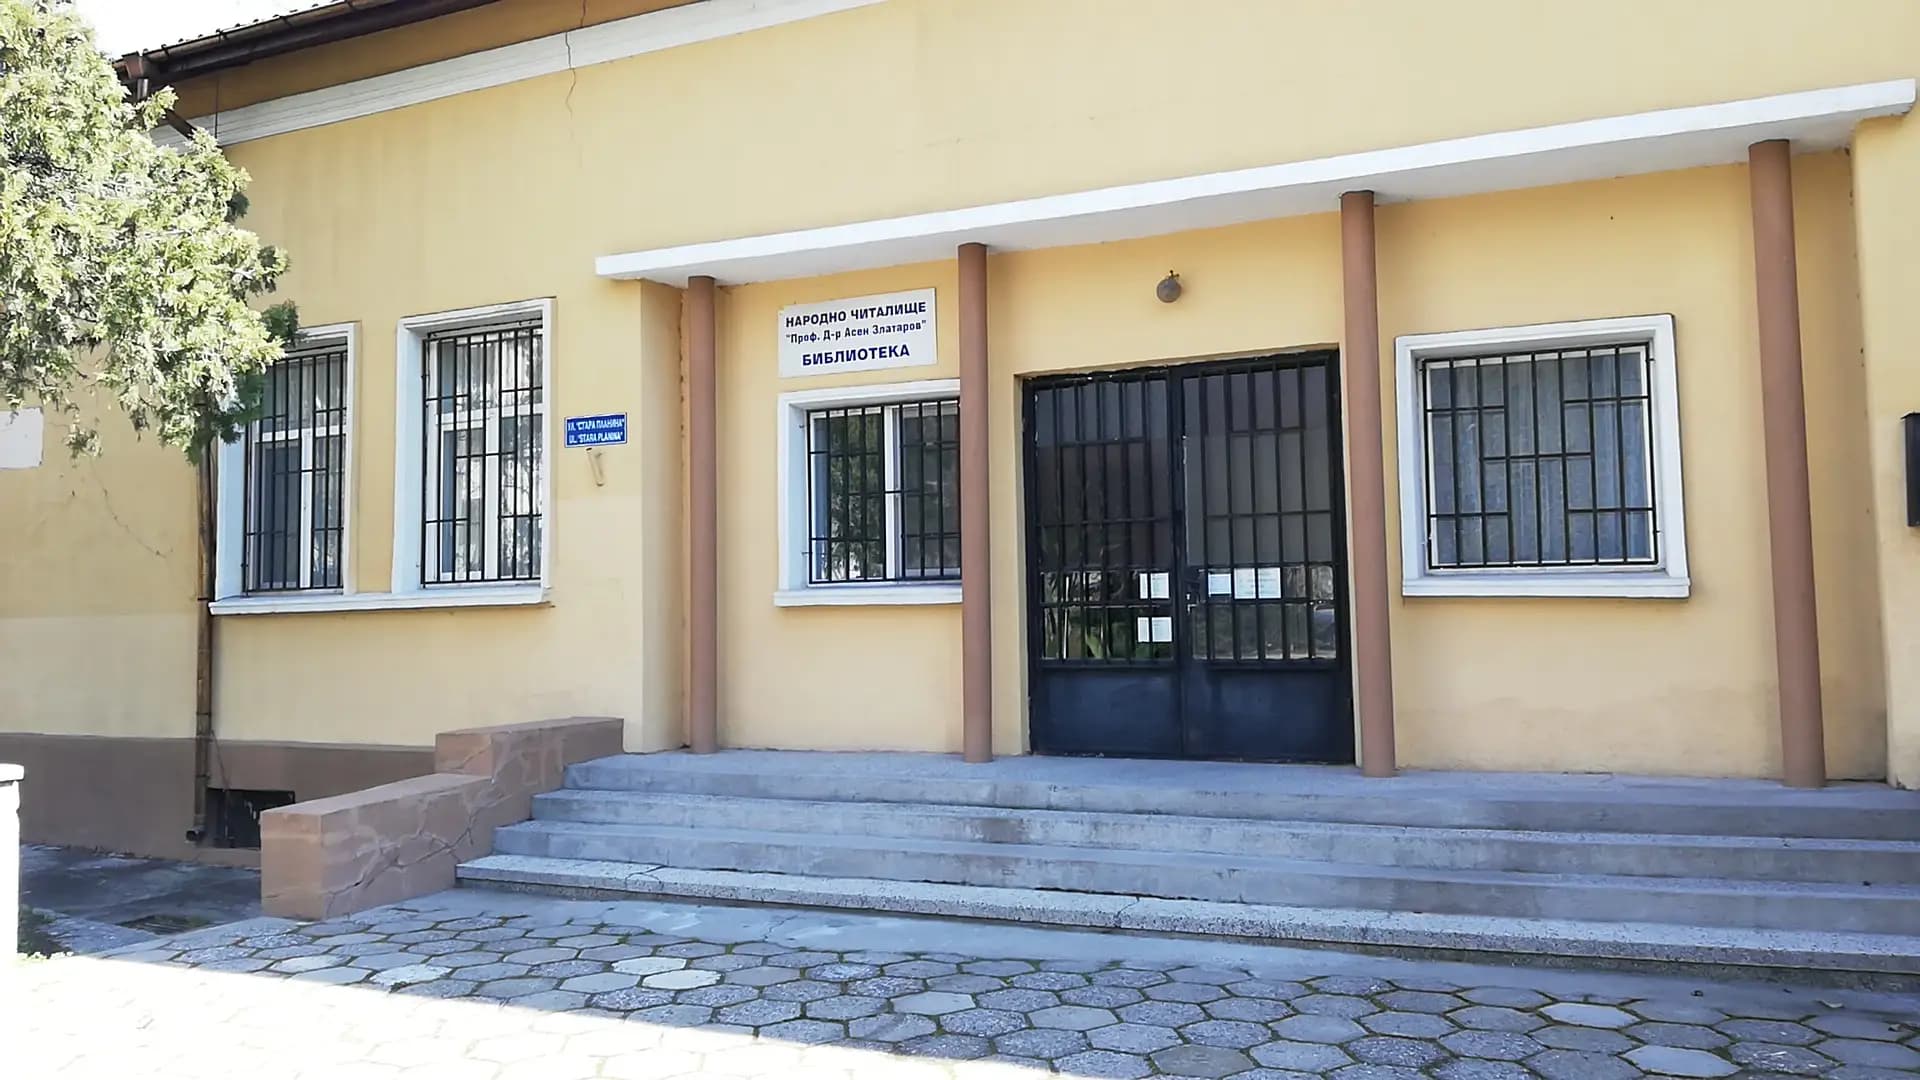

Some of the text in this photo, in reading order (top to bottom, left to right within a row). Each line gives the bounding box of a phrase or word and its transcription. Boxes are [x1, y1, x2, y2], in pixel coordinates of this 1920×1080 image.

[785, 302, 926, 328] НАРОДНО ЧИТАЛИЩЕ
[823, 330, 841, 341] Д-р
[845, 327, 869, 337] Асен
[872, 320, 926, 335] Златаров"
[802, 344, 910, 366] БИБЛИОТЕКА
